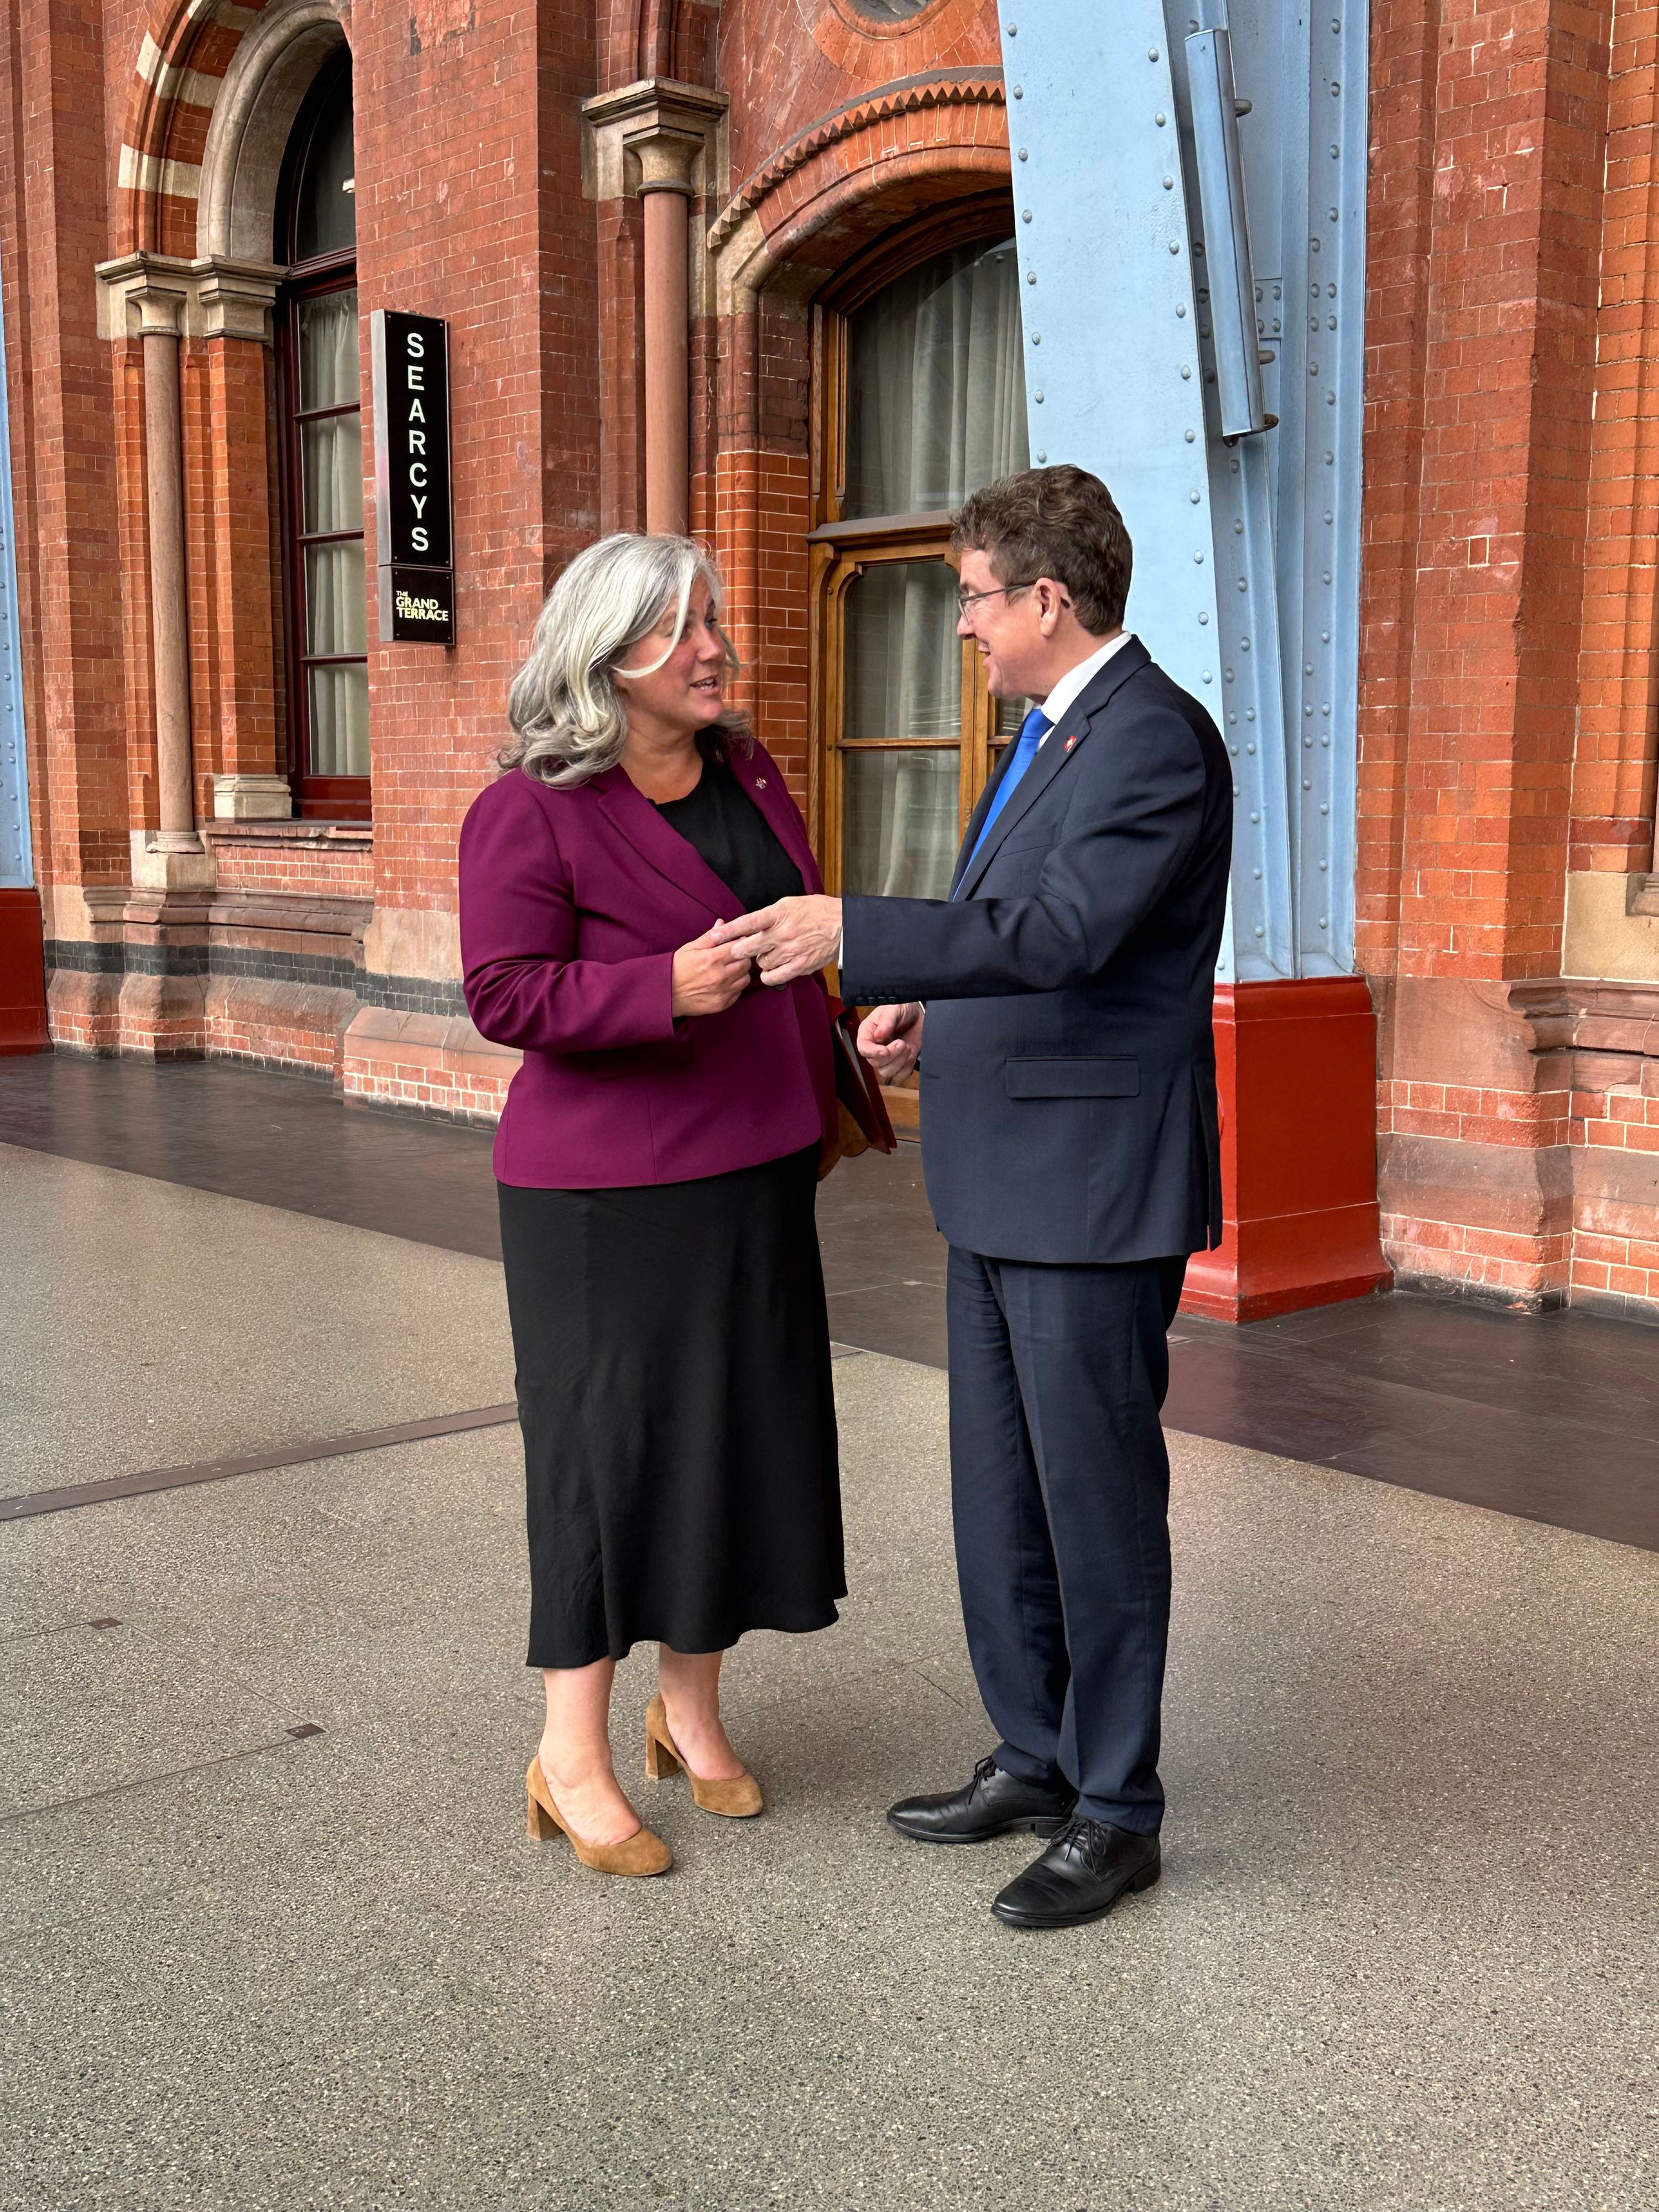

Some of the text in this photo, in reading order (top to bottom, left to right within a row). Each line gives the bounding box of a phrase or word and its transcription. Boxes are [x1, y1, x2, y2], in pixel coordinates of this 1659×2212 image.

[407, 332, 429, 552] SEARCYS
[396, 596, 439, 609] GRAND
[396, 607, 448, 621] TERRACE
